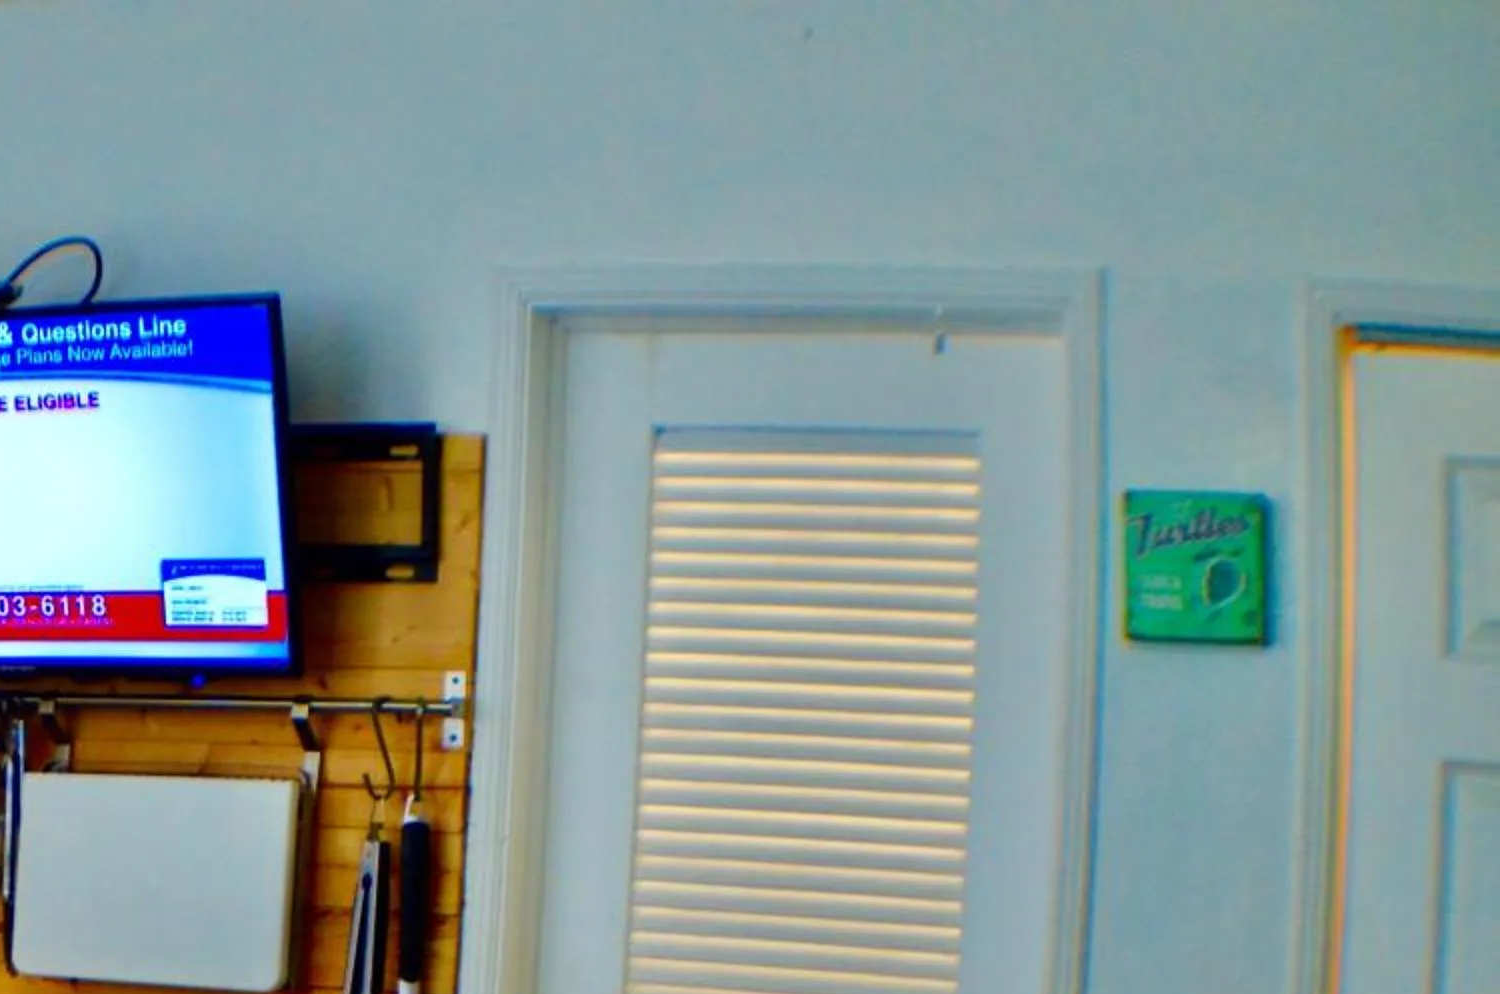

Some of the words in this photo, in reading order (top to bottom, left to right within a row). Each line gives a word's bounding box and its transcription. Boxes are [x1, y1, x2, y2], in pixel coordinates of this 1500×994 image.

[21, 319, 132, 345] Questions
[138, 313, 187, 338] Line
[16, 347, 62, 365] Plans
[67, 345, 105, 362] Now
[110, 339, 193, 360] Available!
[14, 391, 100, 411] ELIGIBLE
